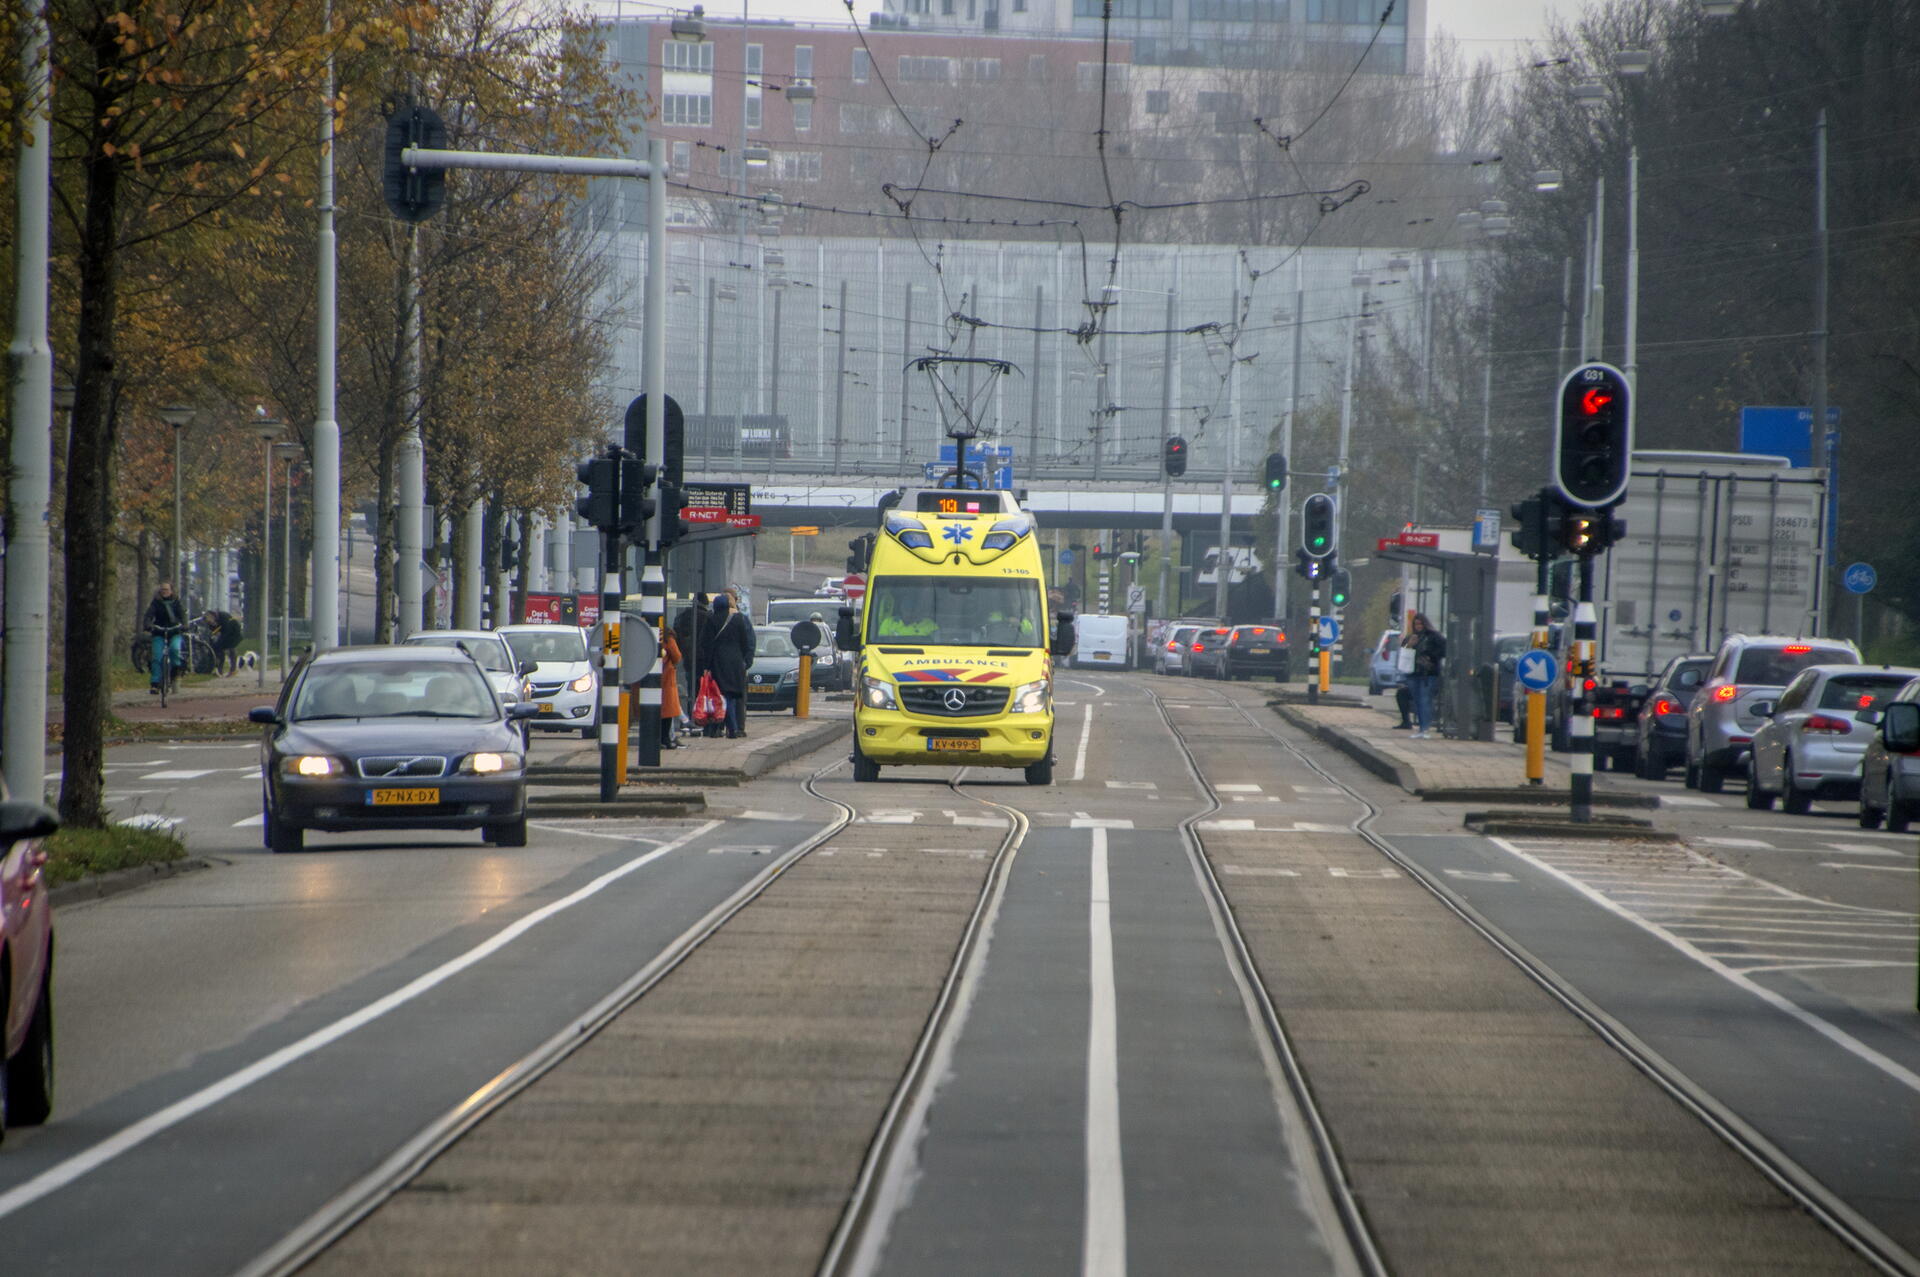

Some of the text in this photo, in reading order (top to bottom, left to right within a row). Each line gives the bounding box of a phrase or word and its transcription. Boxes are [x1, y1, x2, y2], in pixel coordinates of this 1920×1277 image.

[939, 499, 957, 513] 19
[904, 659, 1009, 668] AMBULANCE
[935, 740, 978, 749] KV-499-S
[376, 791, 436, 802] 57-NX-DX
